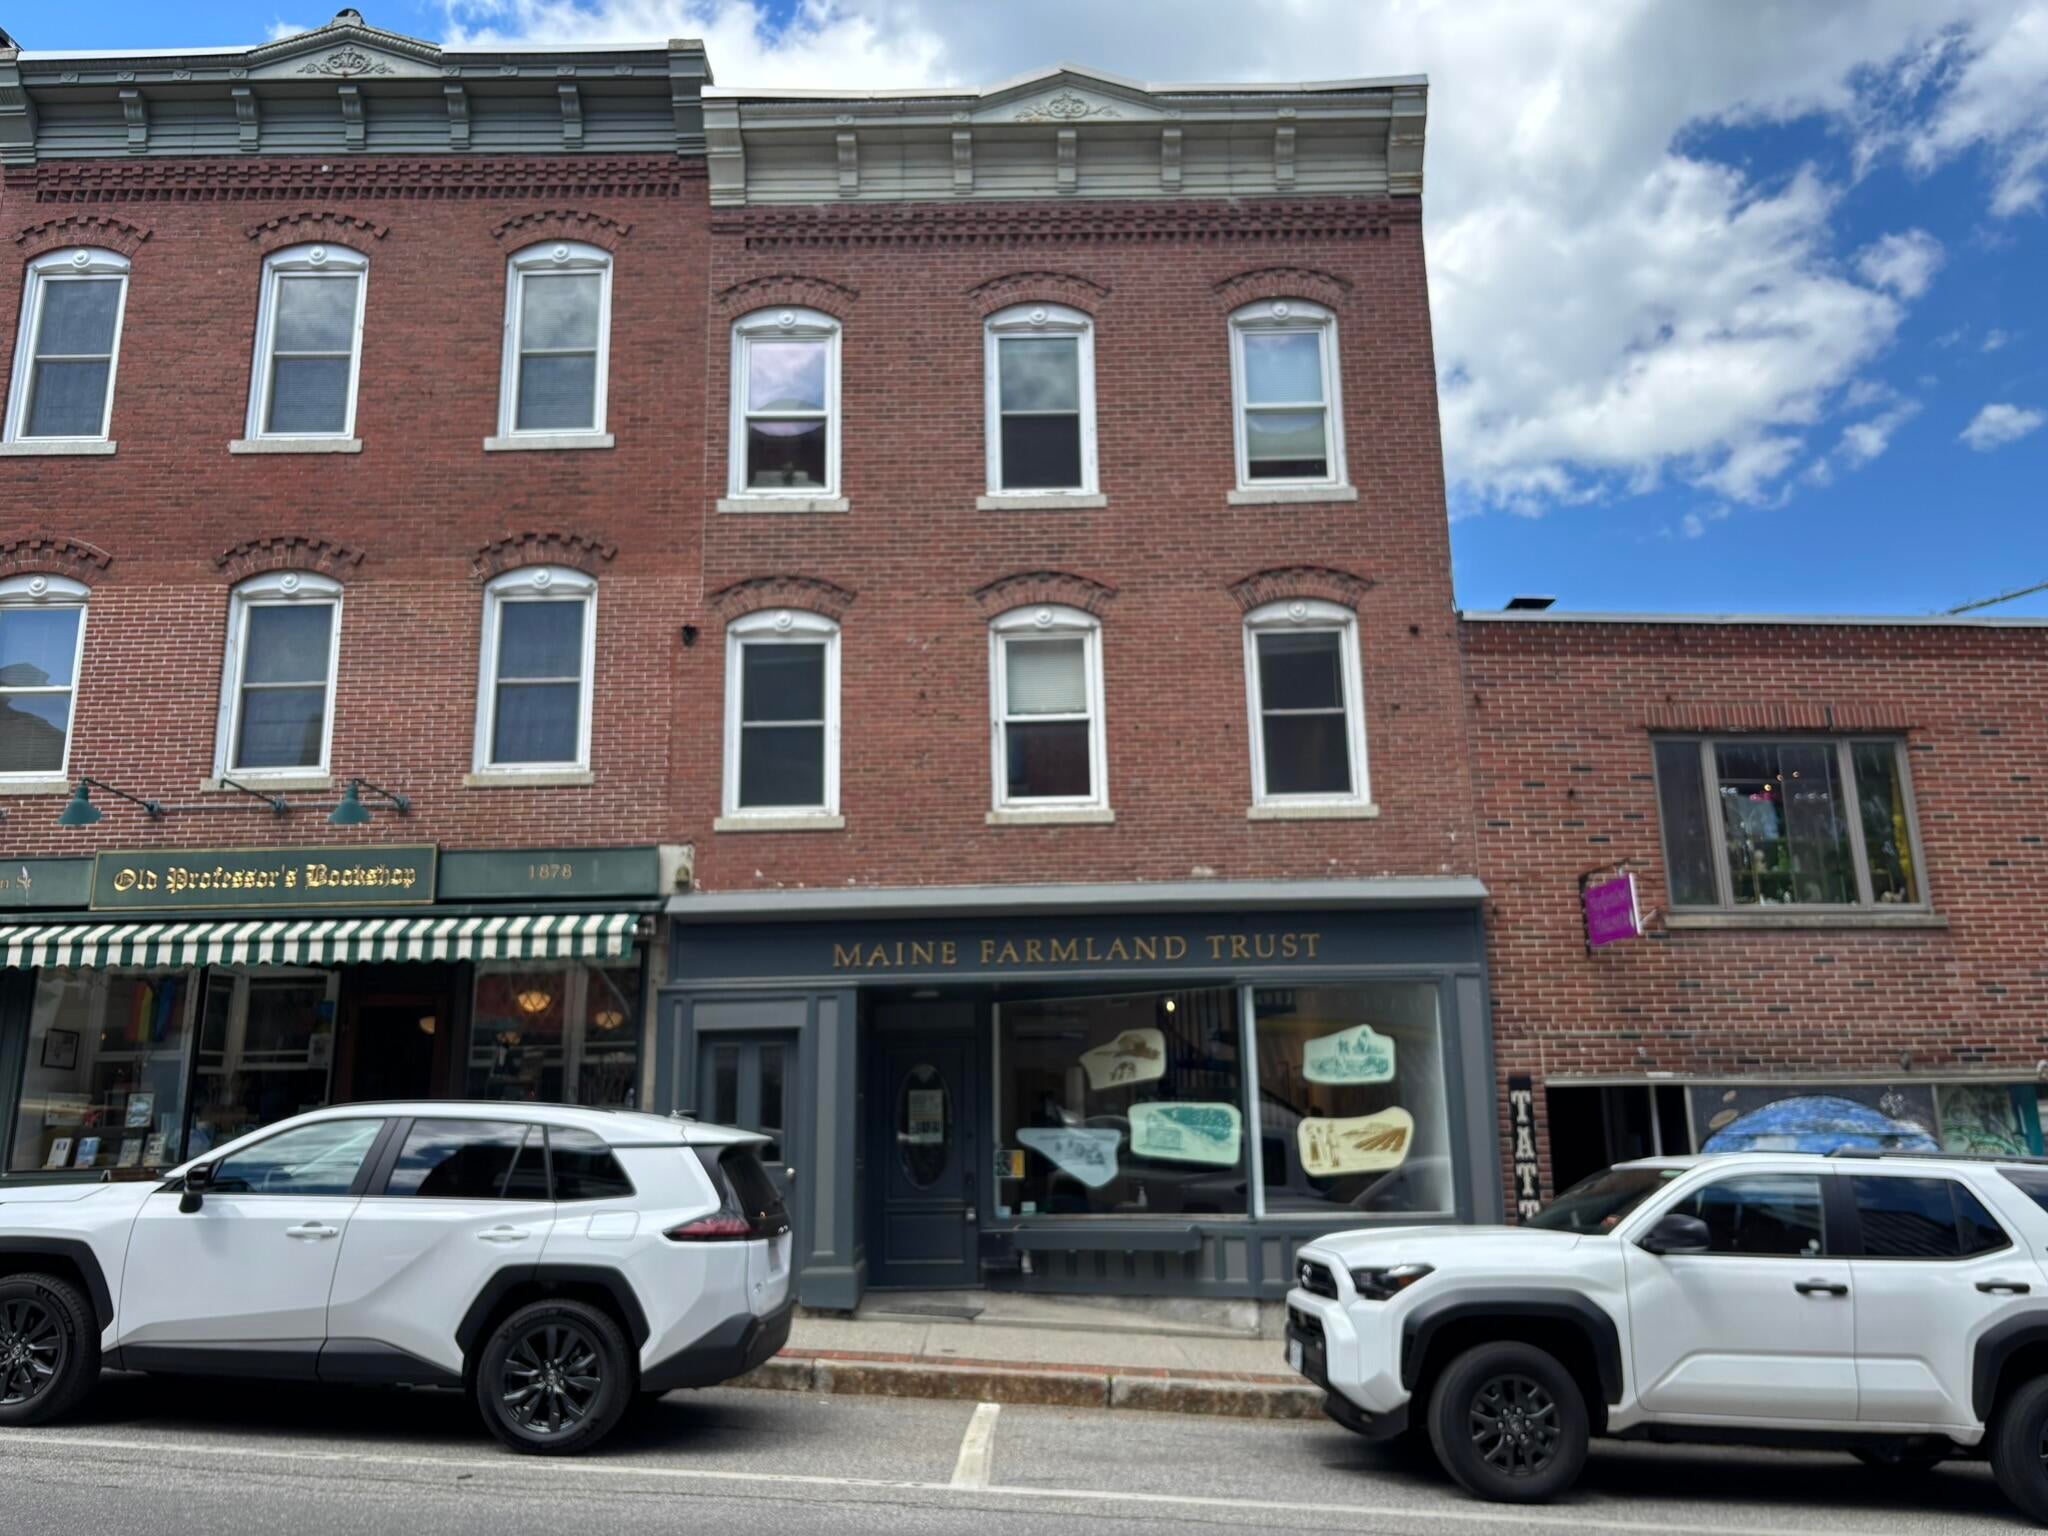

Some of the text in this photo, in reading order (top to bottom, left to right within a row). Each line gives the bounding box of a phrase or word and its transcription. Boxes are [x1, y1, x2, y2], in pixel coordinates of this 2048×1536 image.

[113, 862, 417, 894] Old Professor's Bookshop
[529, 863, 574, 881] 1878
[833, 932, 1321, 967] MAINE FARMLAND TRUST
